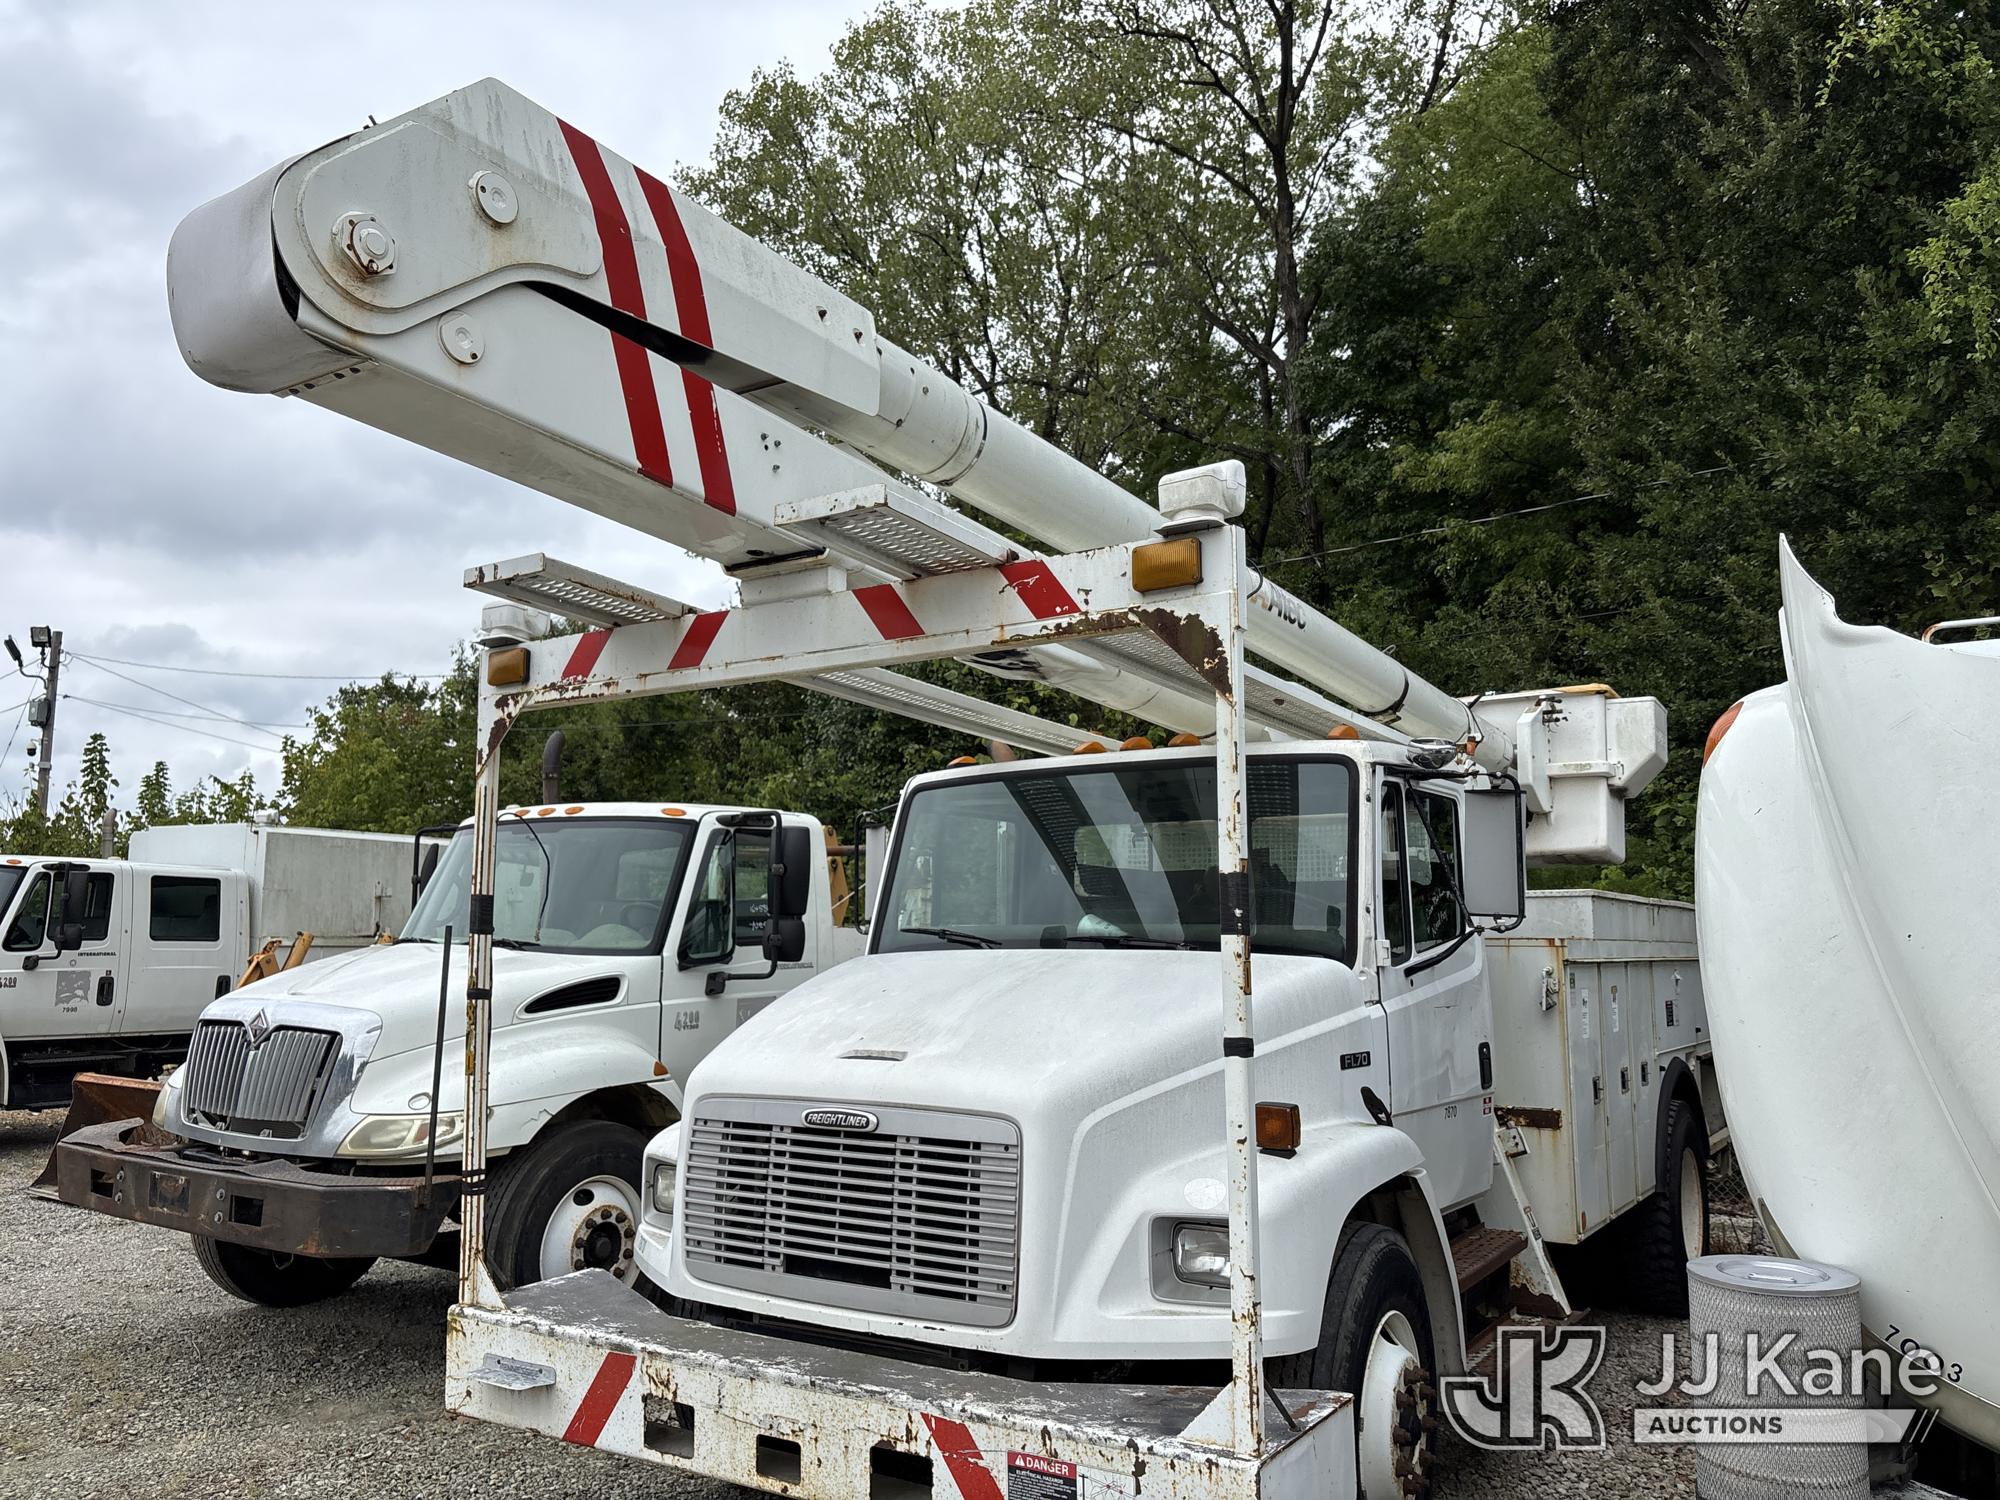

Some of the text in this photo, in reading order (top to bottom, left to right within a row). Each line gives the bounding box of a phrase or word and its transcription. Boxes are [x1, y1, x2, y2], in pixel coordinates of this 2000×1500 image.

[1344, 1053, 1368, 1068] FL70
[806, 1113, 867, 1127] FREIGHTLINER
[1026, 1456, 1069, 1476] DANGER
